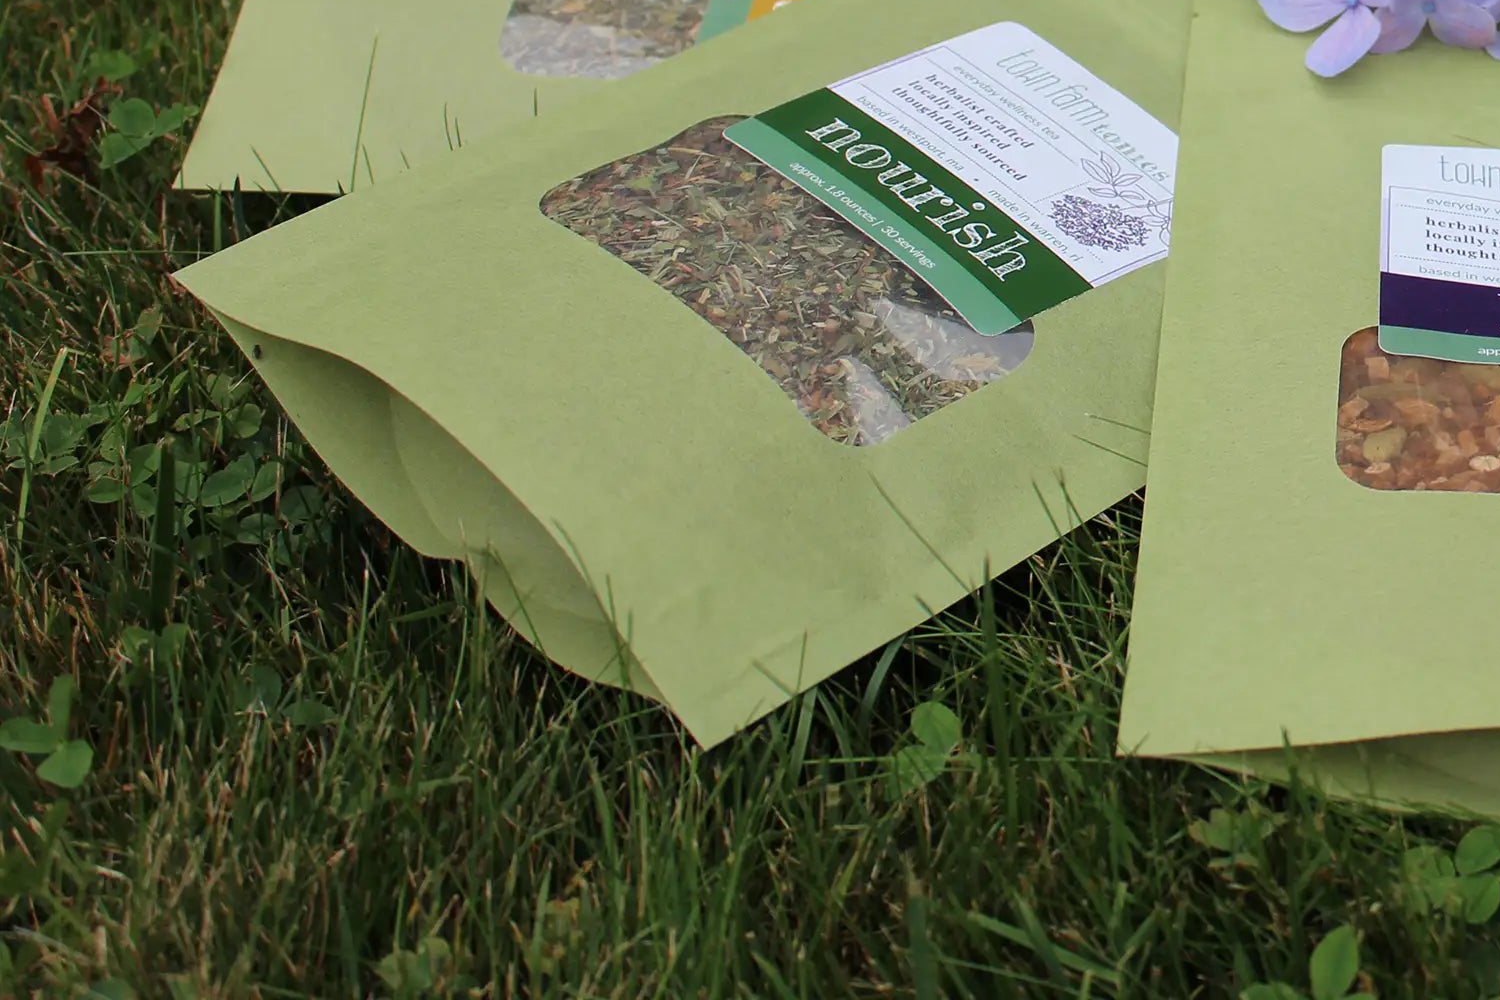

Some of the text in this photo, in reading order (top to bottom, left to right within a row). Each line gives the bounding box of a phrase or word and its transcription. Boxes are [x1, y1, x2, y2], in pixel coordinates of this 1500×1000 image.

[892, 86, 1028, 182] thoughtfully sourced
[908, 80, 1012, 151] locally inspired
[925, 73, 1035, 149] herbalist crafted
[953, 64, 1061, 141] everyday wellness tea
[996, 49, 1171, 182] town farm tonics
[804, 116, 1032, 283] nourish
[857, 95, 888, 119] based
[886, 111, 901, 126] in
[945, 156, 965, 172] ma
[988, 189, 1019, 212] made
[1017, 210, 1031, 222] in
[1030, 221, 1069, 255] warren,
[1426, 196, 1490, 215] everyday
[789, 162, 936, 270] approx. 1.8 ounces 30 servings
[1426, 230, 1486, 248] locally
[1418, 265, 1461, 279] based
[1465, 271, 1479, 280] in
